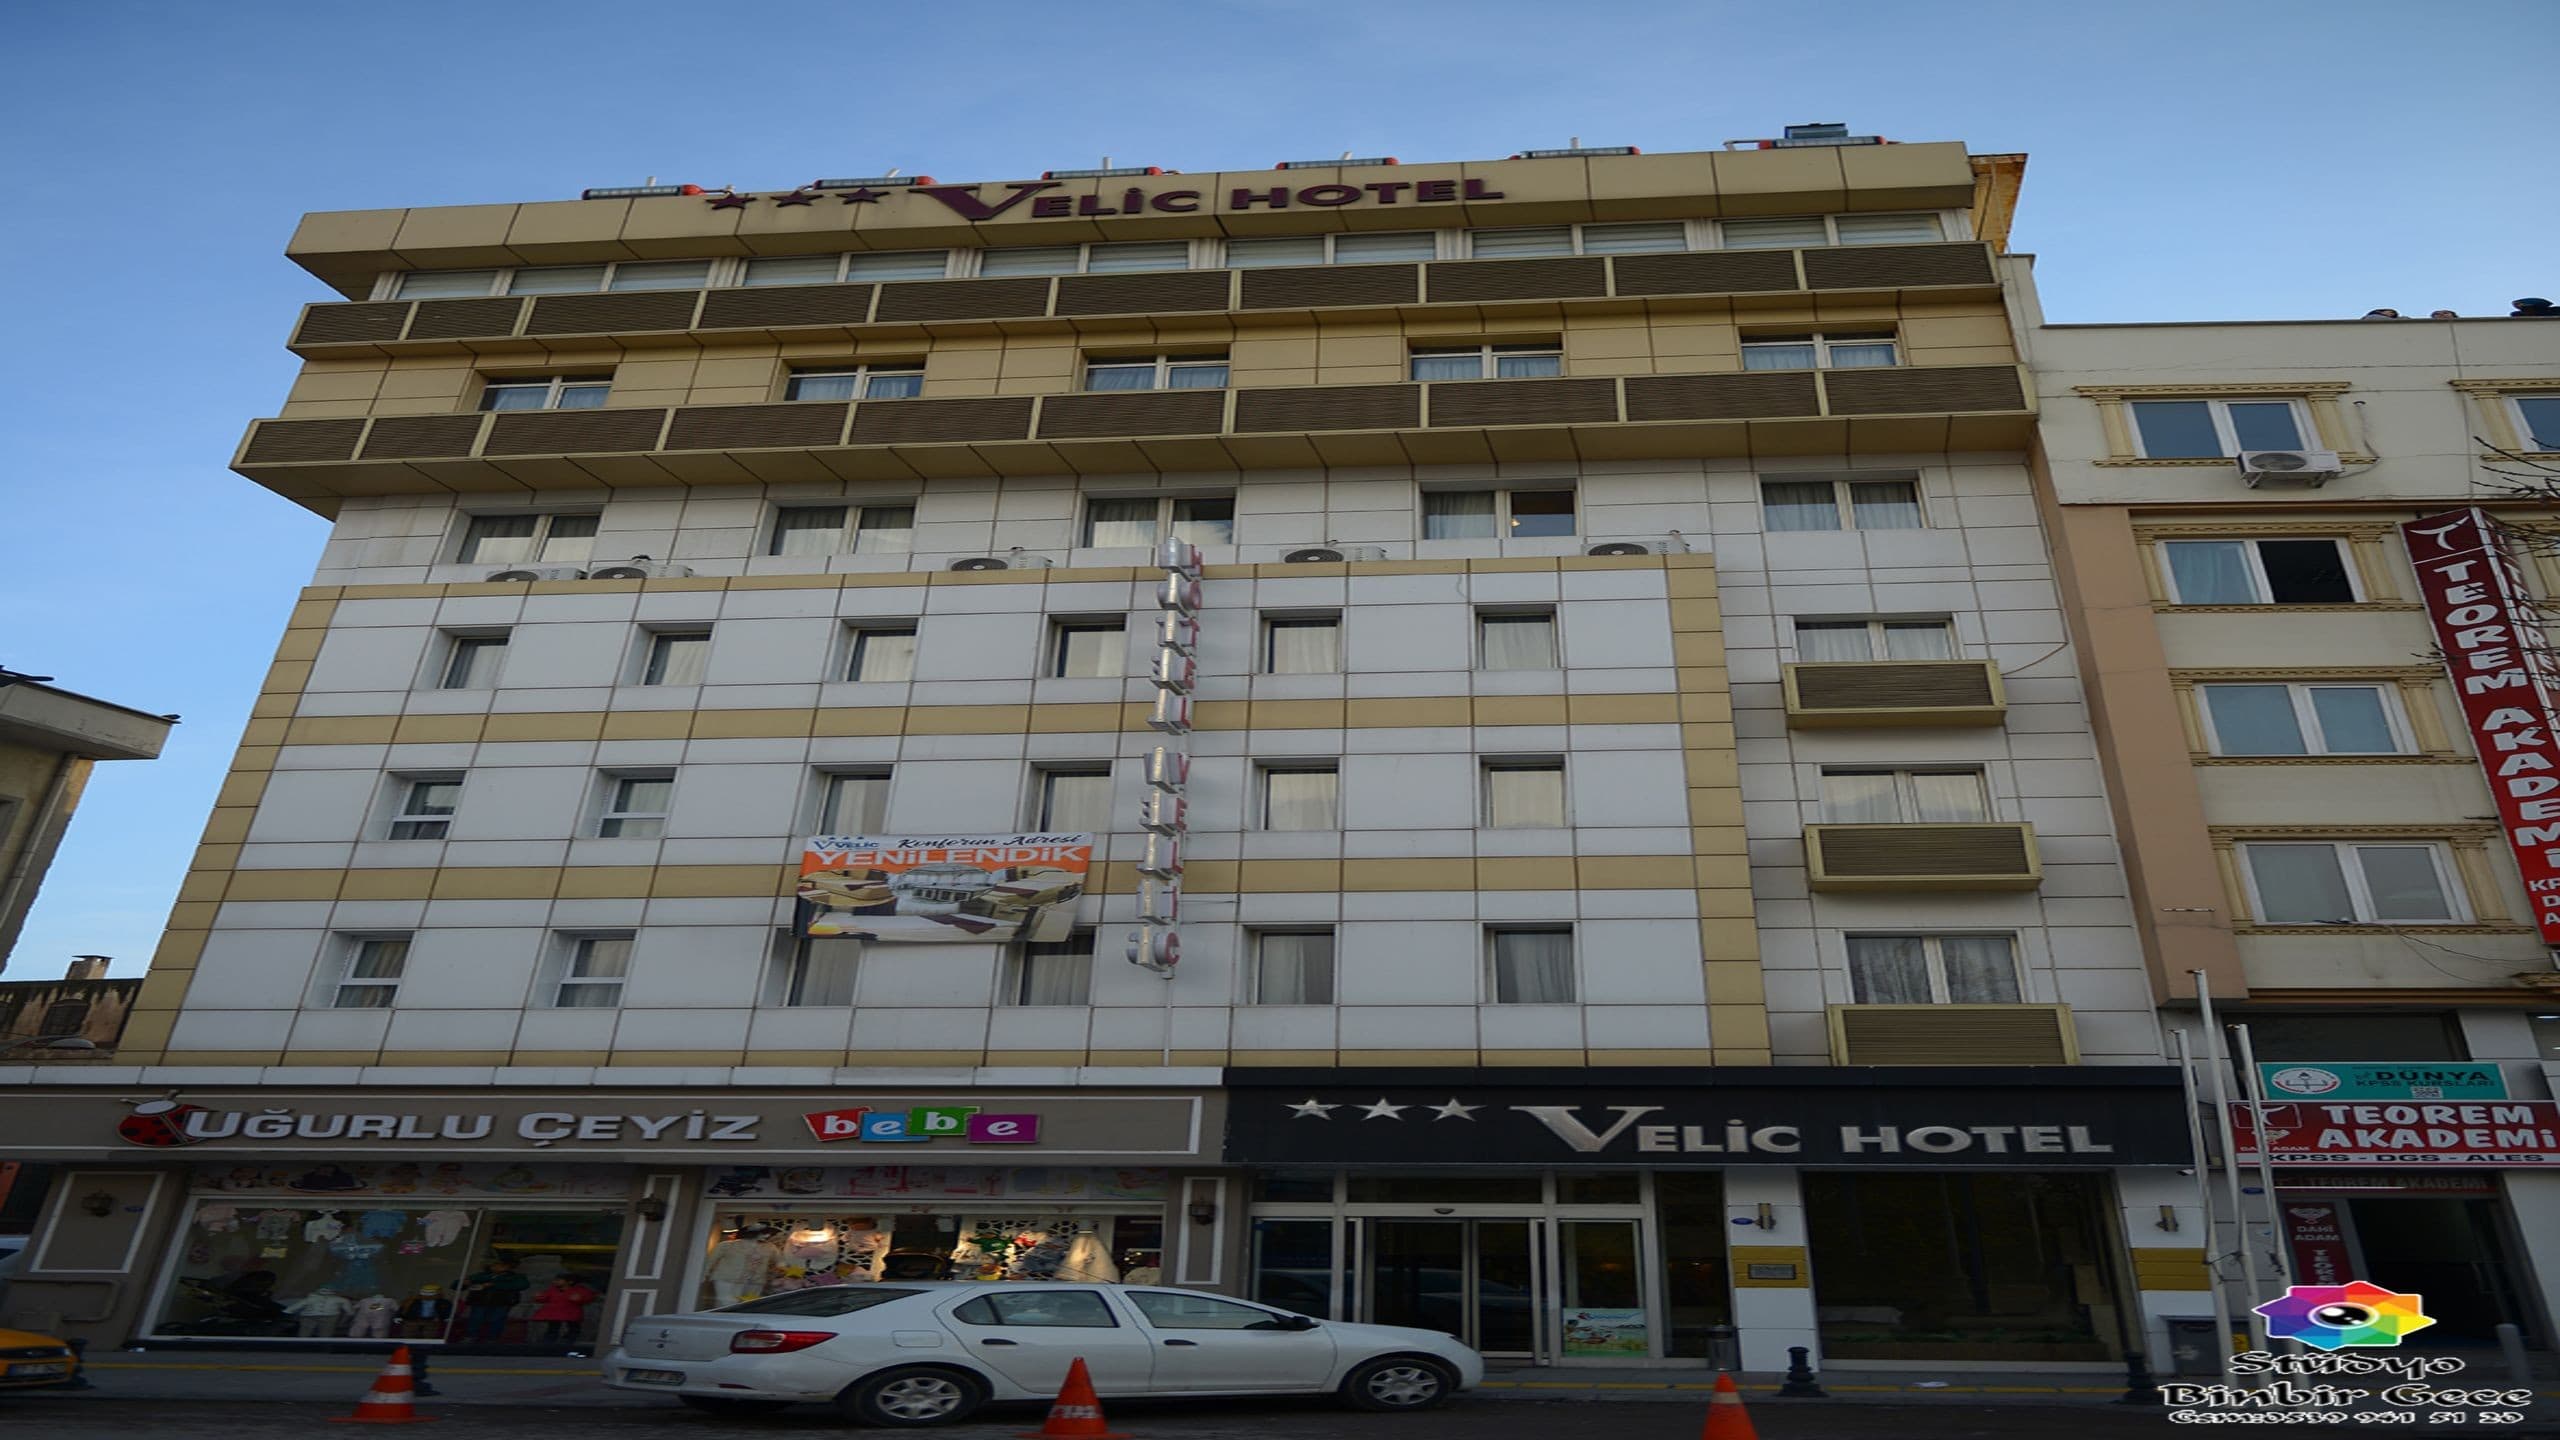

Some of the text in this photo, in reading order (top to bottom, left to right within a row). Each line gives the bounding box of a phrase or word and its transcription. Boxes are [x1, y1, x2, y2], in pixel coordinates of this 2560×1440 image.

[1230, 179, 1504, 210] HOTEL
[1148, 538, 1204, 735] HOTEL
[2433, 558, 2529, 695] TEOREM
[2375, 1068, 2490, 1081] DÜNYA
[184, 1108, 493, 1140] UĞURLU
[823, 1111, 1020, 1137] bebe
[2319, 1104, 2536, 1126] TEOREM
[1840, 1125, 2114, 1153] HOTEL
[2268, 1153, 2351, 1162] KPSS
[2375, 1153, 2441, 1162] DGS
[2465, 1153, 2545, 1162] ALES
